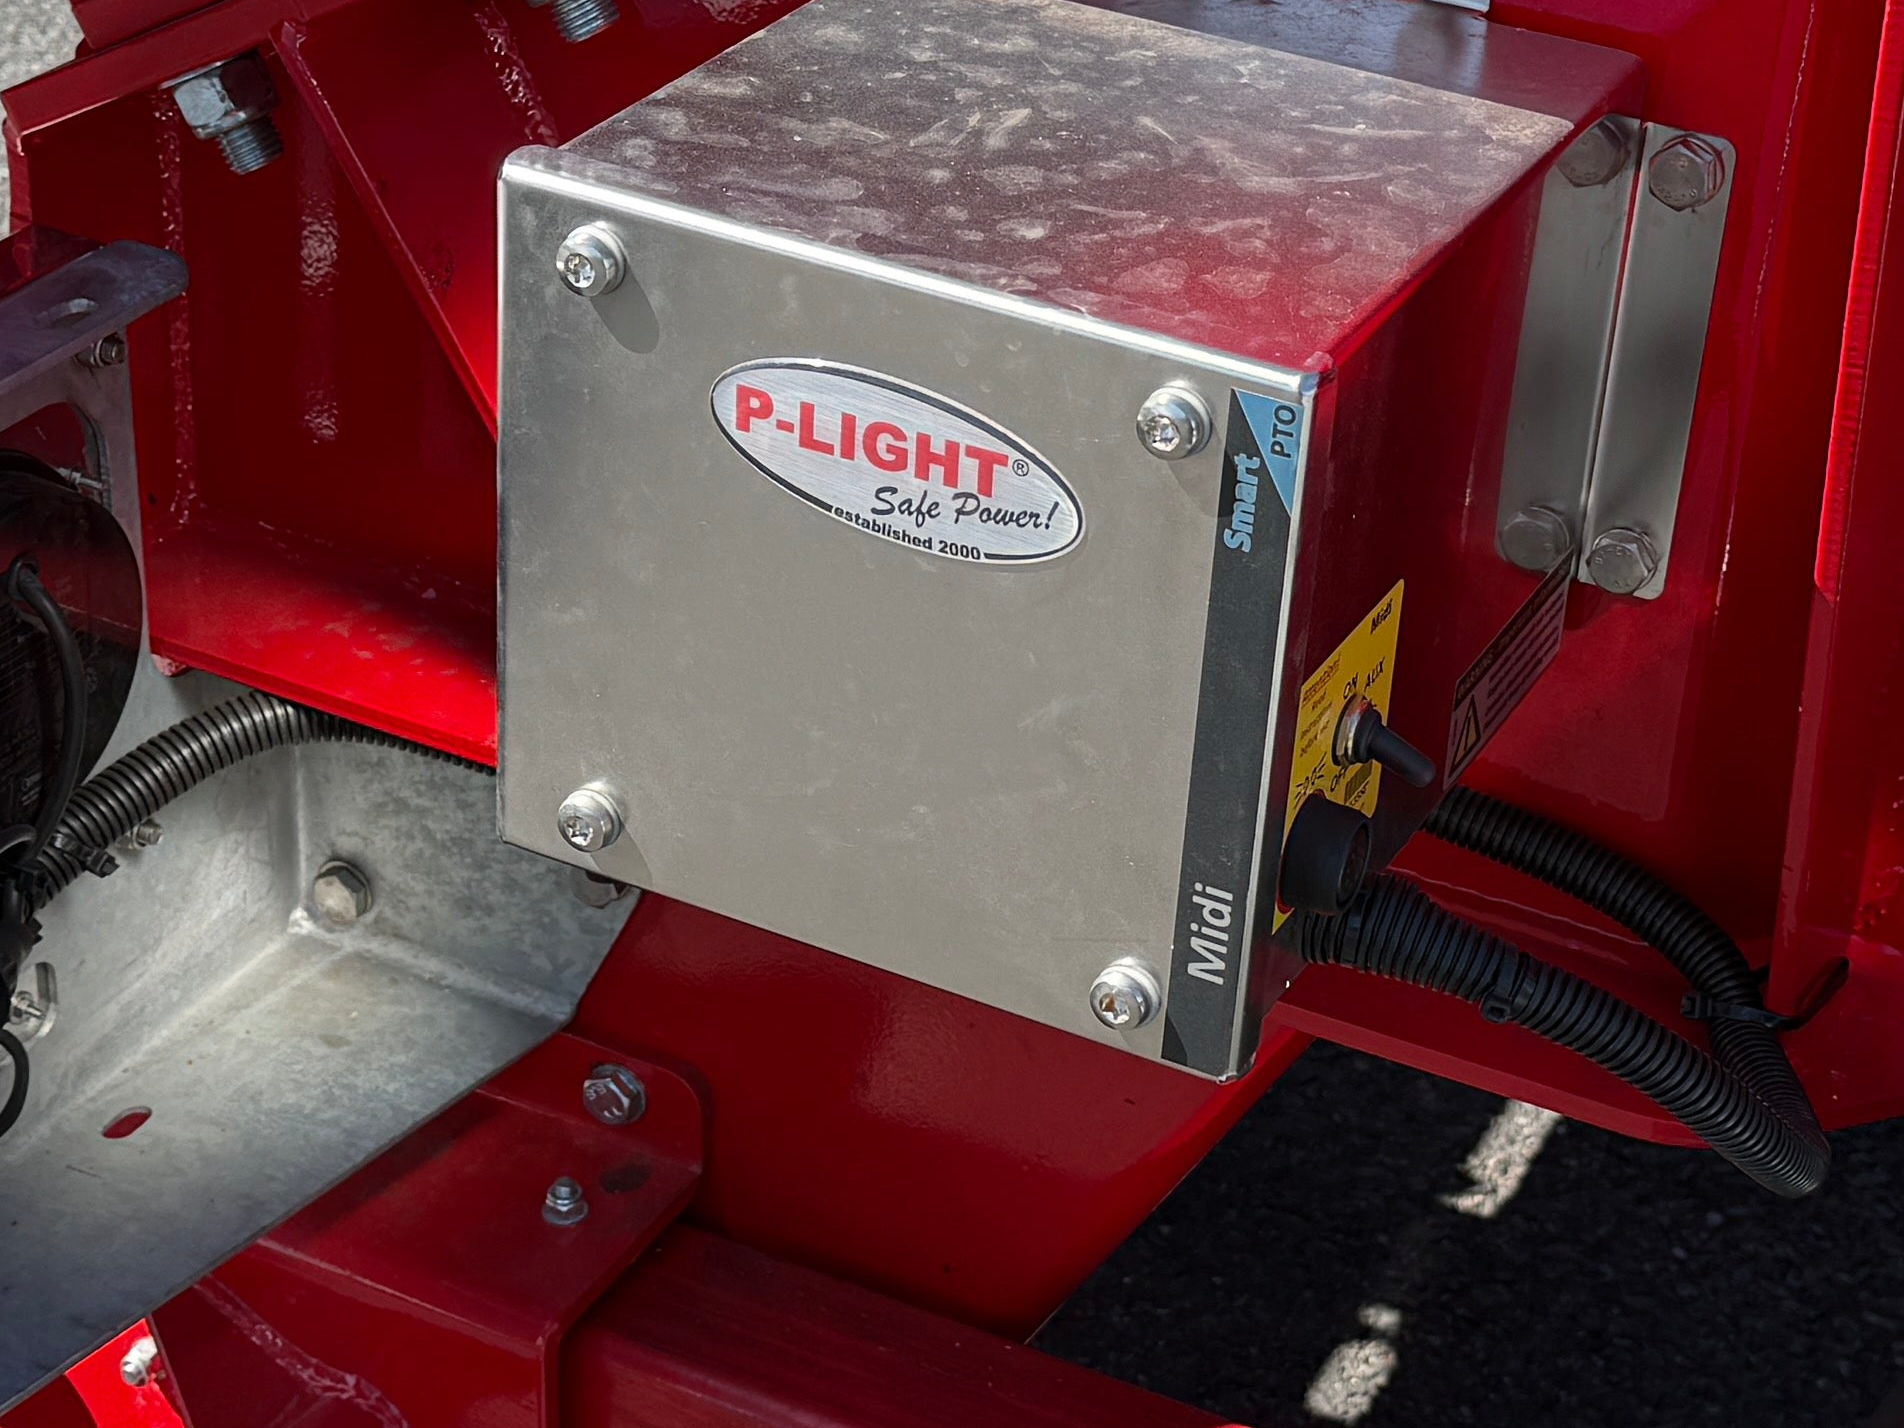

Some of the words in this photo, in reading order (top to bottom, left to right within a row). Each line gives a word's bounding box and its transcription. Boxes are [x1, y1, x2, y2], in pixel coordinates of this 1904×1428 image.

[1270, 404, 1298, 459] PTO
[870, 485, 942, 529] Safe
[950, 490, 1060, 531] Power!
[1223, 452, 1262, 554] Smart
[833, 506, 934, 552] established
[938, 539, 982, 561] 2000
[1187, 881, 1234, 986] Midi
